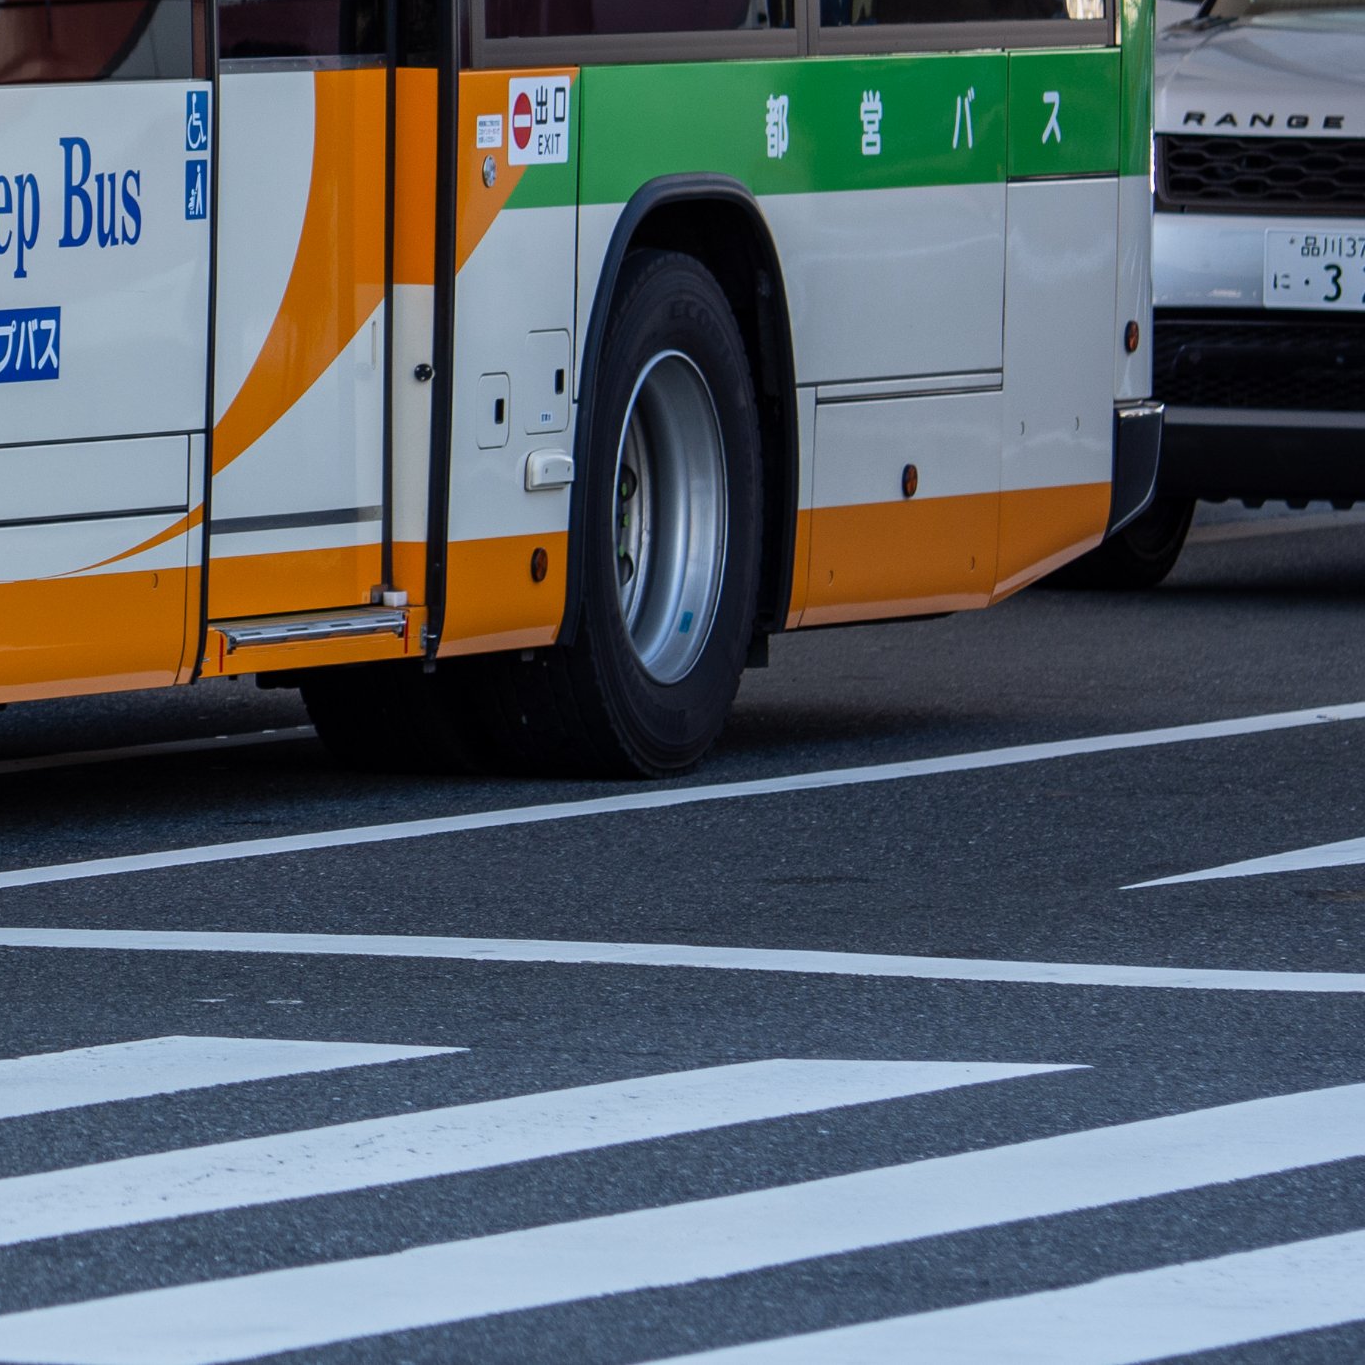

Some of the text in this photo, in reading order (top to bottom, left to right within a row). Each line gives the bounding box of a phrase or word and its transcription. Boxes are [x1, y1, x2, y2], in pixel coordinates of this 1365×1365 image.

[535, 85, 566, 125] 出口
[1182, 112, 1346, 130] RANGE
[537, 133, 561, 155] EXIT
[58, 136, 142, 248] Bus
